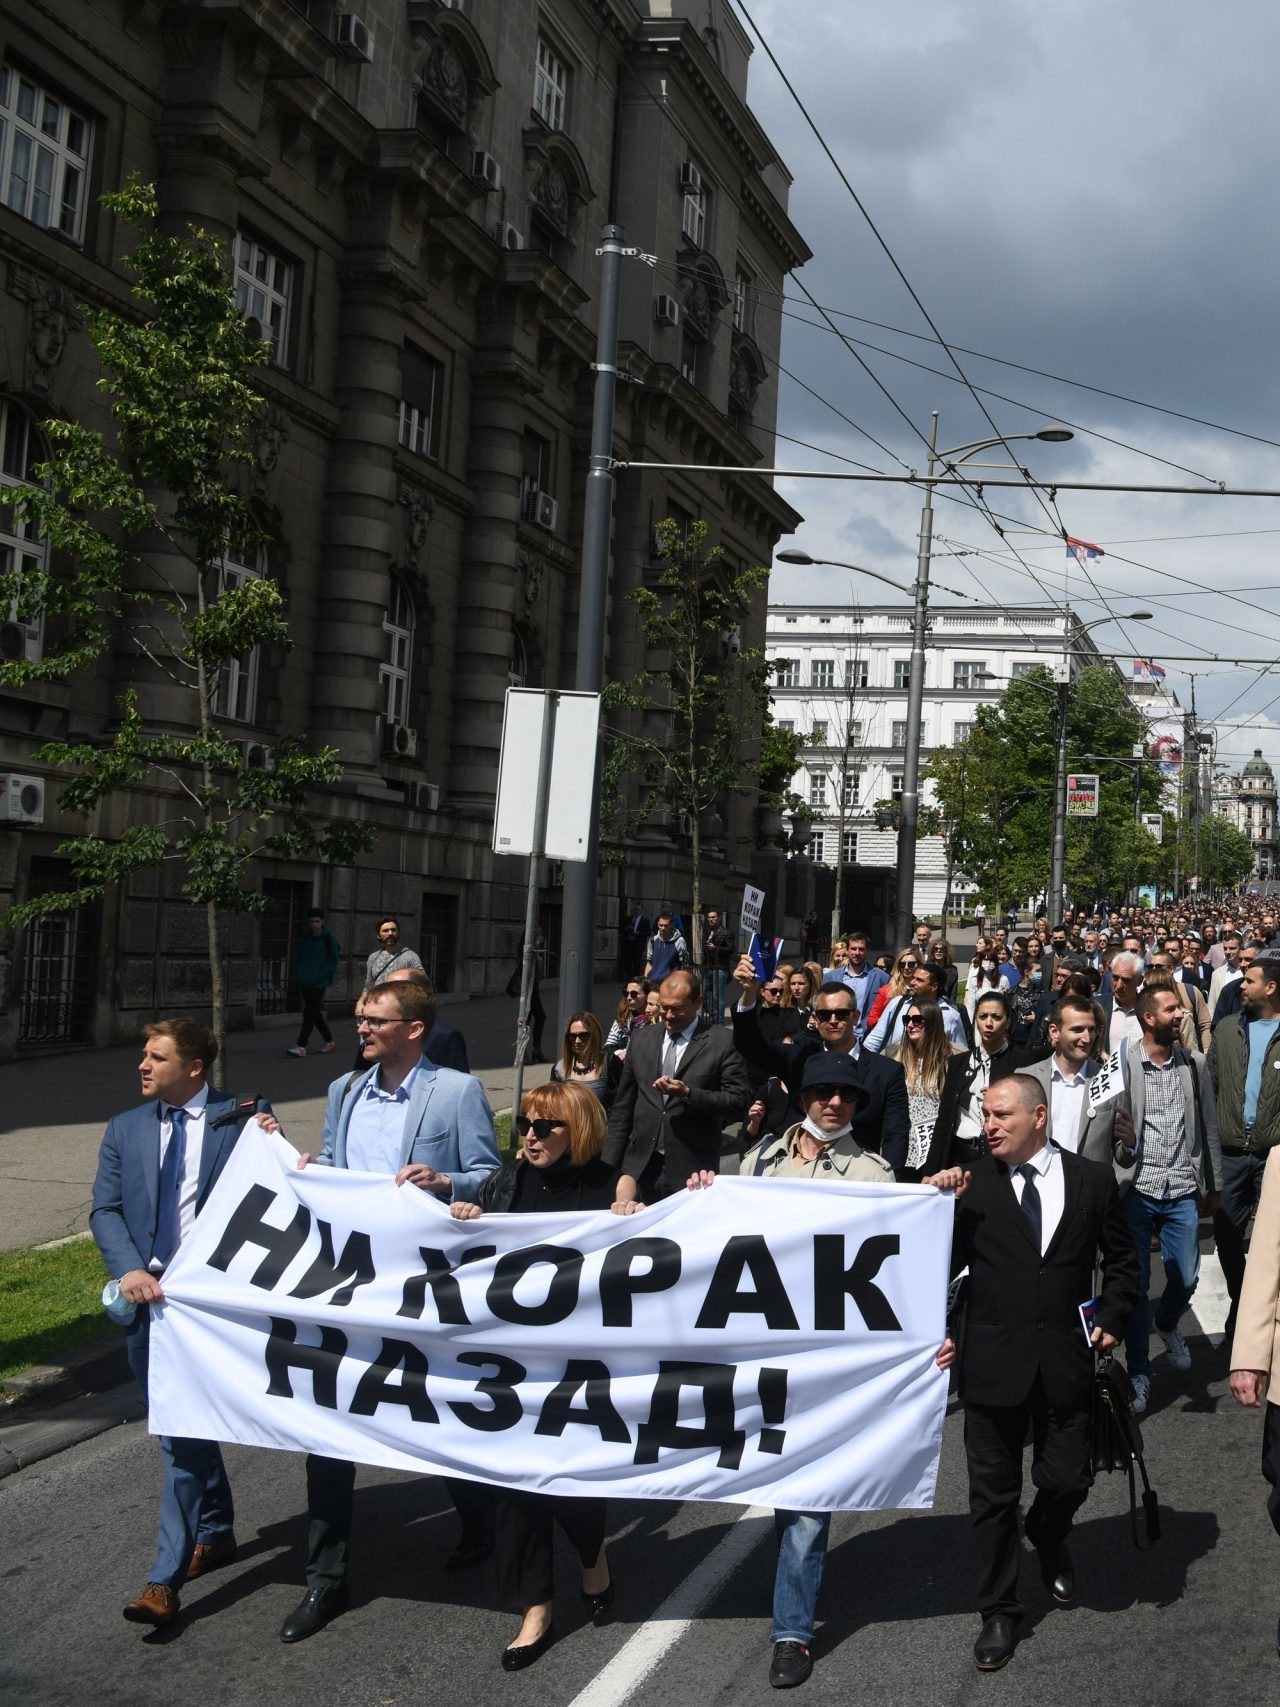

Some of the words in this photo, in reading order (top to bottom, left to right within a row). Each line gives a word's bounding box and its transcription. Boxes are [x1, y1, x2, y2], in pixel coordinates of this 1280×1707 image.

[1100, 1063, 1111, 1093] РАК
[1109, 1051, 1119, 1073] НИ
[207, 1184, 376, 1307] НИ
[396, 1234, 903, 1332] КОРАК
[265, 1316, 788, 1471] НАЗАД!
